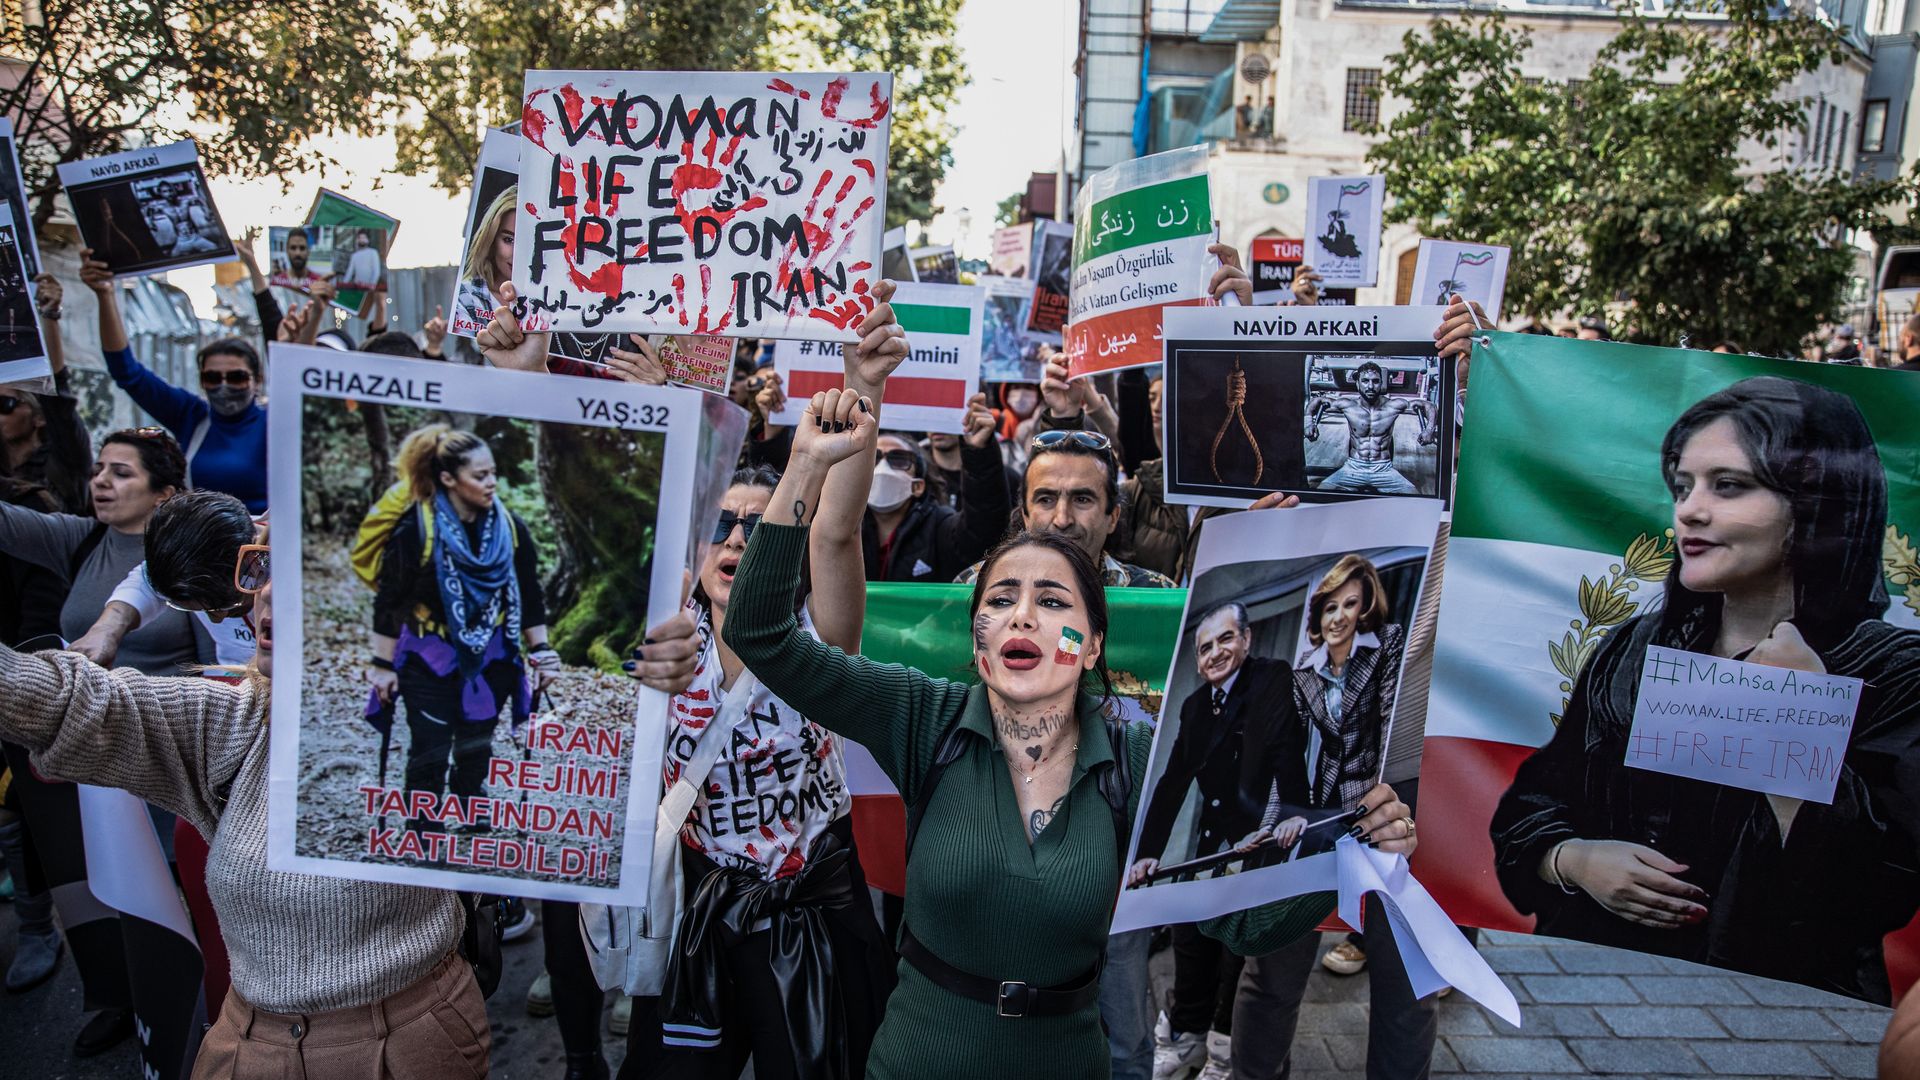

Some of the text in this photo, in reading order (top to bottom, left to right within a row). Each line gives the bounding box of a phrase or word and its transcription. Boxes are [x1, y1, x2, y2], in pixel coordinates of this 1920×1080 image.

[549, 154, 681, 209] LIFE
[1091, 210, 1136, 247] زندگی
[1157, 199, 1189, 228] زن
[529, 213, 810, 285] FREEDOM
[1087, 265, 1115, 285] Yaşam
[1116, 246, 1175, 278] Özgürlük
[1272, 241, 1303, 257] TÜR
[729, 261, 848, 329] IRAN
[1089, 293, 1118, 311] Vatan
[1120, 282, 1179, 301] Gelişme
[1098, 332, 1137, 357] میهن
[1233, 315, 1378, 336] NAVİD AFKARİ
[662, 363, 725, 388] LEDILDILER
[663, 350, 726, 374] TARAFINDAN
[302, 367, 670, 429] GHAZALE YAŞ:32
[527, 712, 622, 758] İRAN
[488, 757, 618, 800] REJİMİ
[702, 748, 803, 801] LIFE
[1762, 739, 1847, 782] IRAN
[359, 785, 613, 840] TARAFINDAN
[367, 826, 610, 880] KATLEDİLDİ!
